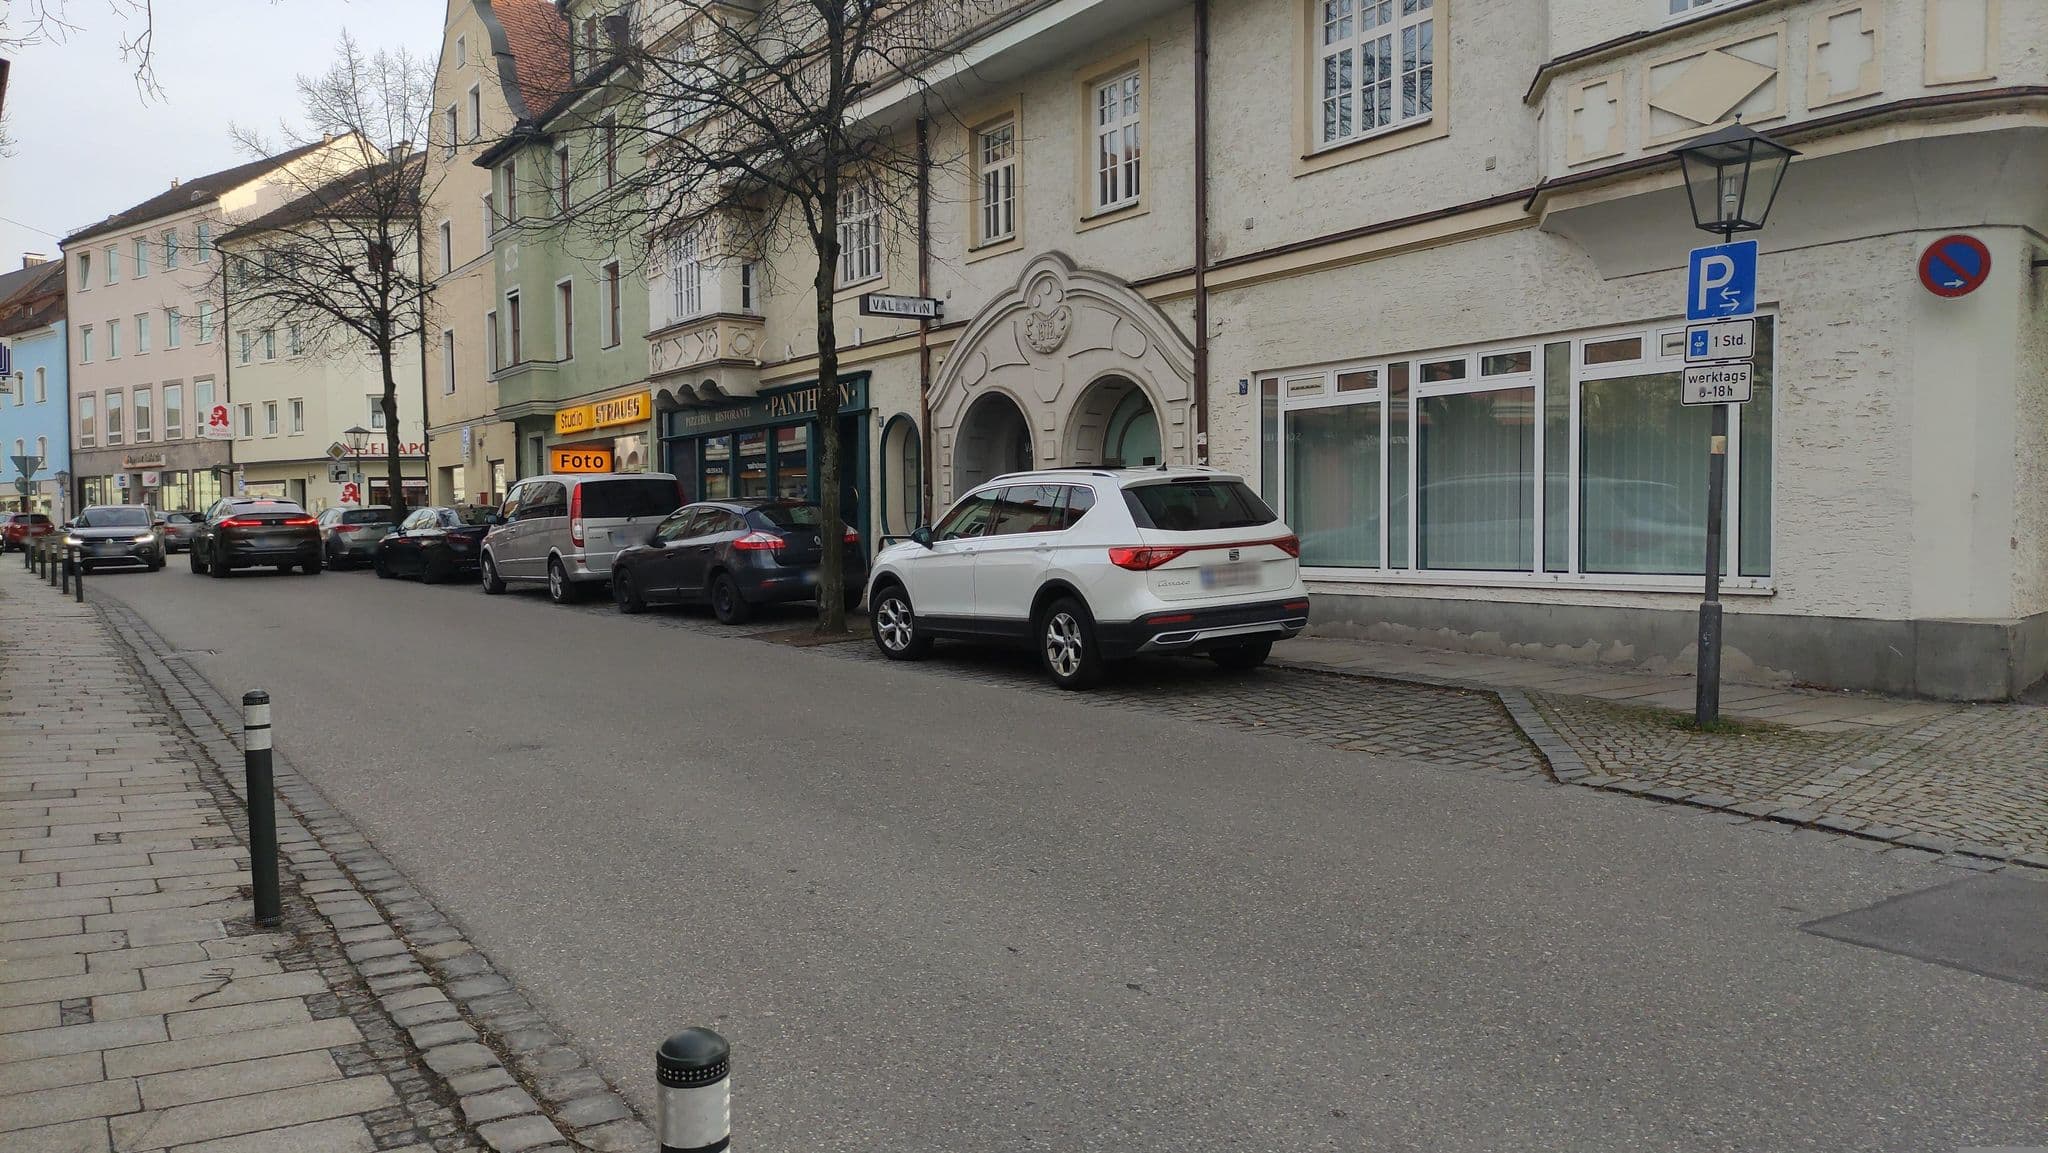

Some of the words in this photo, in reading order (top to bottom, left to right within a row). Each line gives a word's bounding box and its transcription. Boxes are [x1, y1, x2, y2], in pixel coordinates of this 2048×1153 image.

[1697, 254, 1736, 311] P
[1713, 336, 1719, 348] 1
[1722, 334, 1747, 347] Std.
[1688, 371, 1747, 385] werktags
[771, 382, 850, 418] PANTHN
[560, 410, 583, 430] Studio
[595, 397, 641, 424] STRAUSS
[560, 453, 604, 468] Foto
